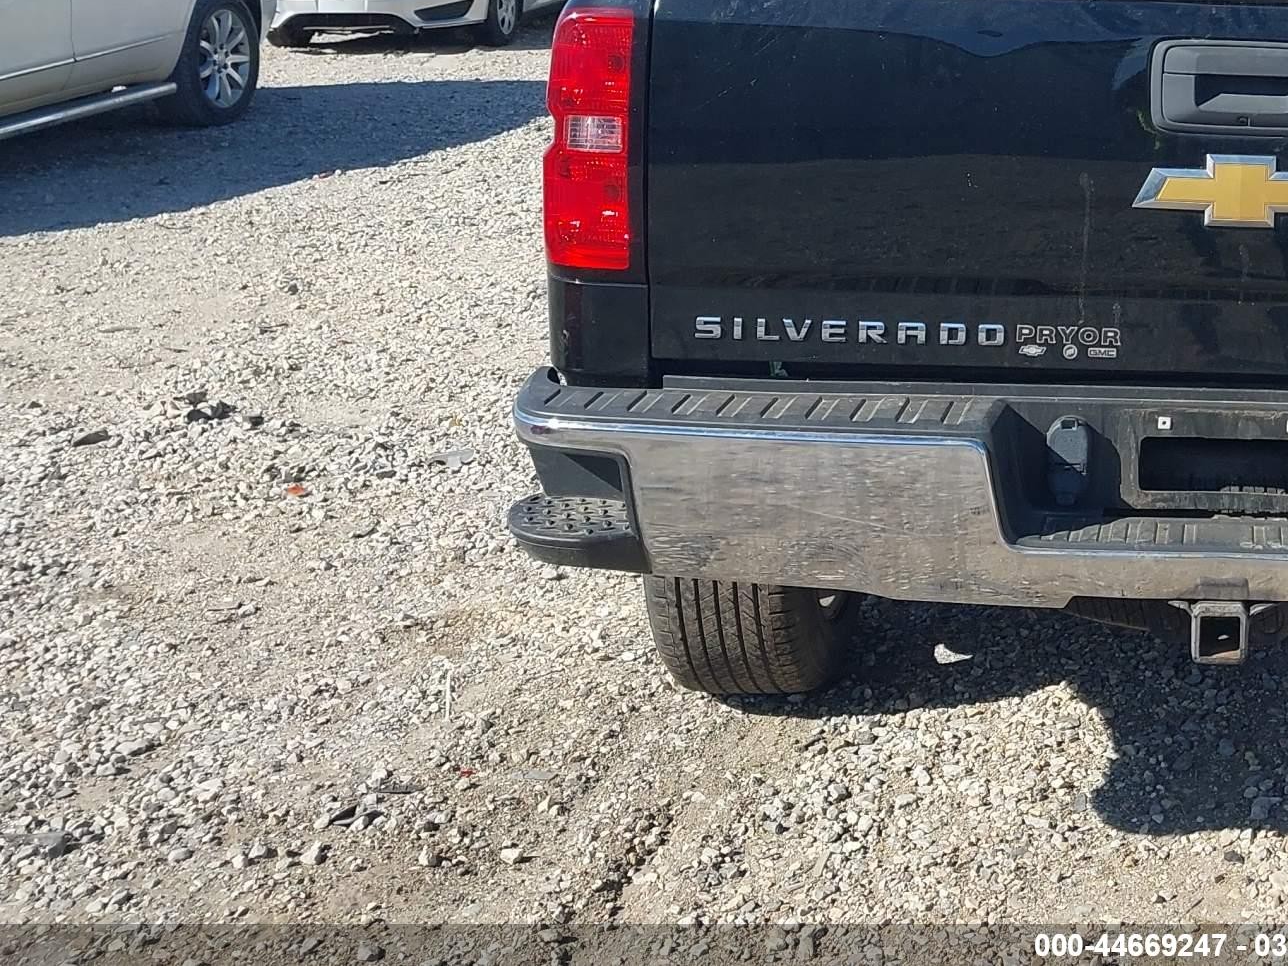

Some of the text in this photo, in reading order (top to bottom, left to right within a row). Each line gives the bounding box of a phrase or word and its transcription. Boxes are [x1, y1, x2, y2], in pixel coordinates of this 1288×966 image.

[694, 316, 1005, 347] SILVERADO
[1016, 324, 1121, 346] PRYOR
[1088, 347, 1117, 358] GMC
